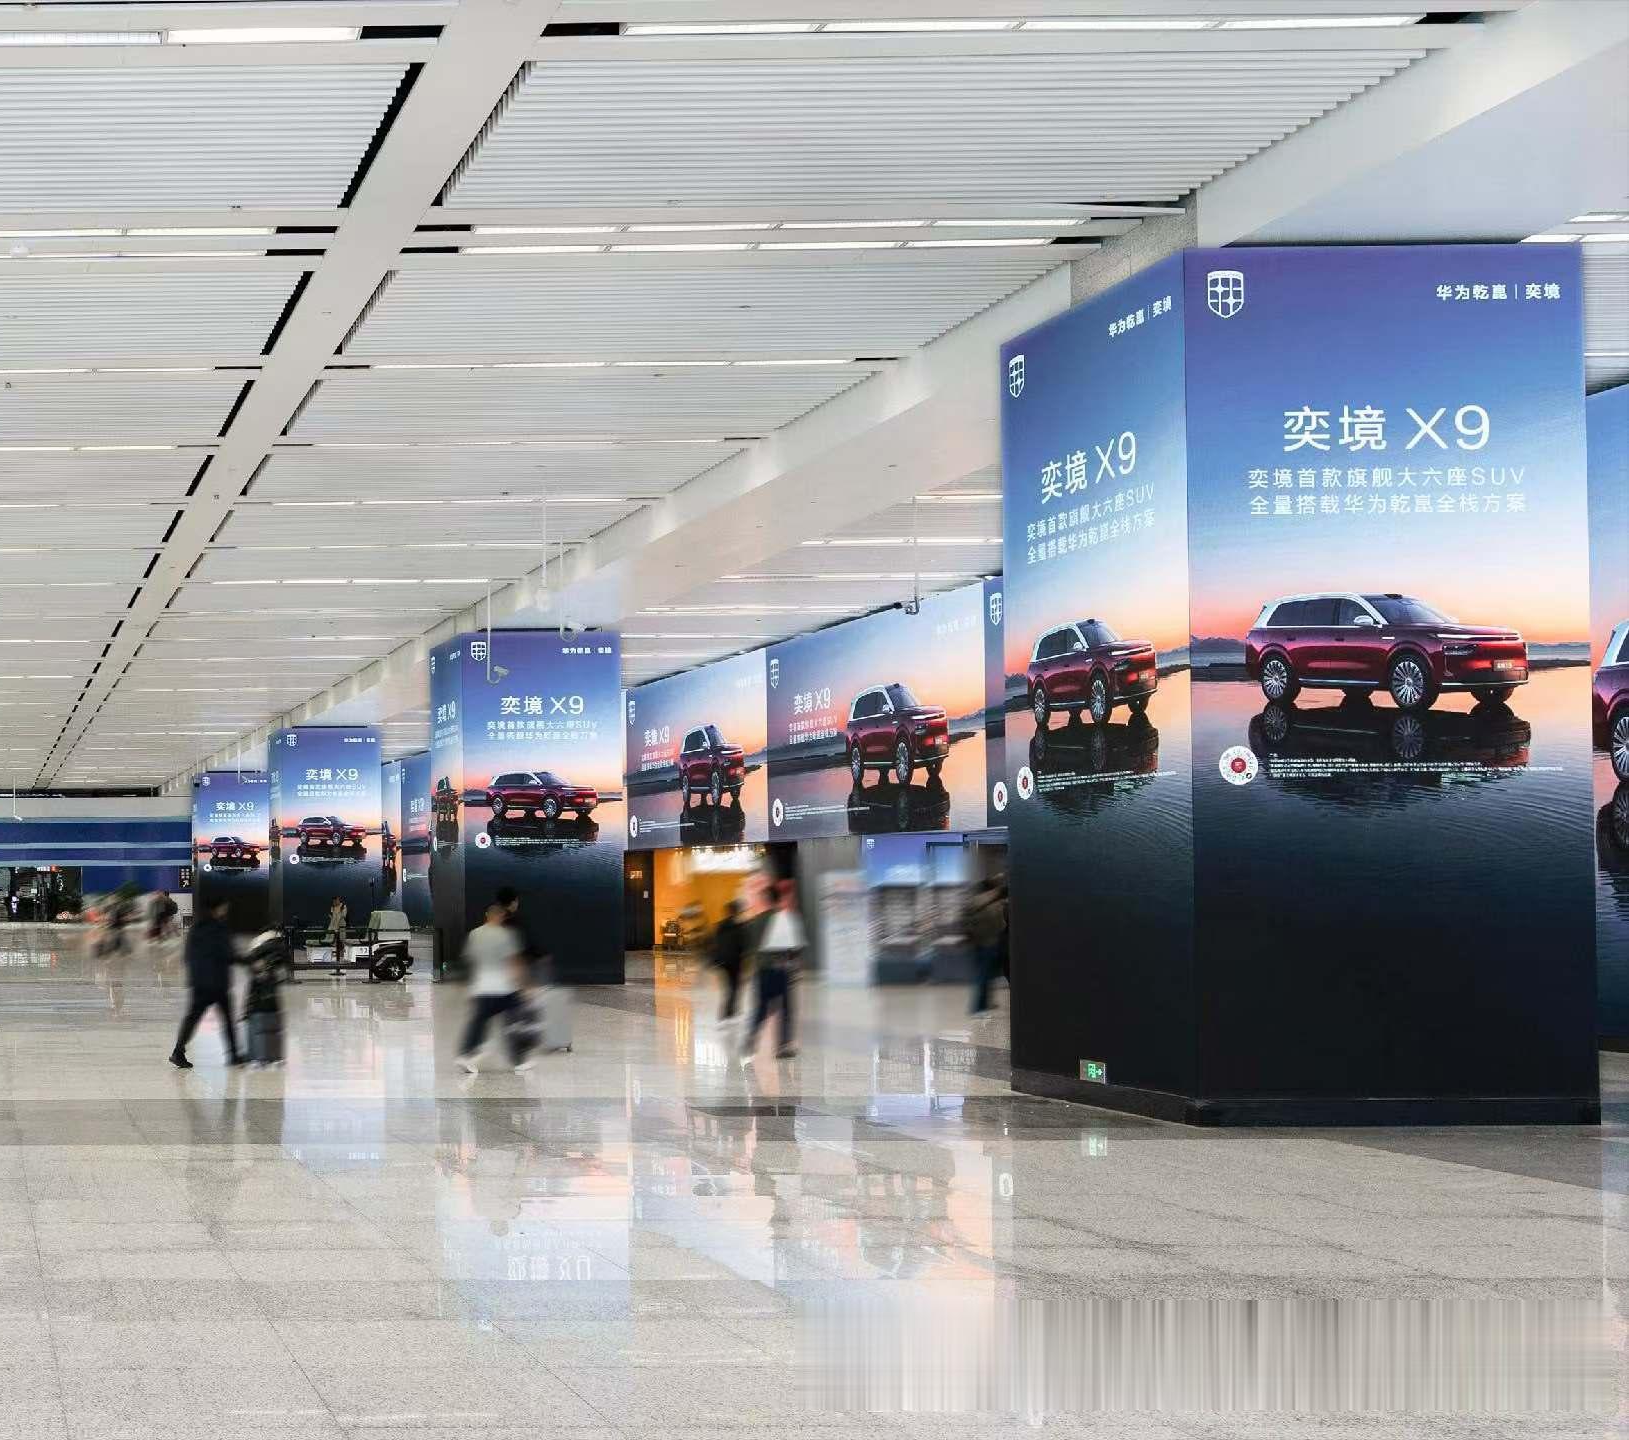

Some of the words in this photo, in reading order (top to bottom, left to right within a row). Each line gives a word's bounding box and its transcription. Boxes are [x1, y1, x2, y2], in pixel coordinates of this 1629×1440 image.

[1525, 283, 1561, 300] 奕境
[1283, 405, 1387, 451] 奕境
[1405, 404, 1490, 450] X9
[1041, 450, 1088, 505] 奕境
[1094, 431, 1136, 484] X9
[1248, 468, 1524, 489] 奕境首款旗舰大六座SUV
[500, 696, 543, 715] 奕境
[549, 695, 584, 715] X9
[814, 688, 830, 711] X9
[336, 768, 359, 780] X9
